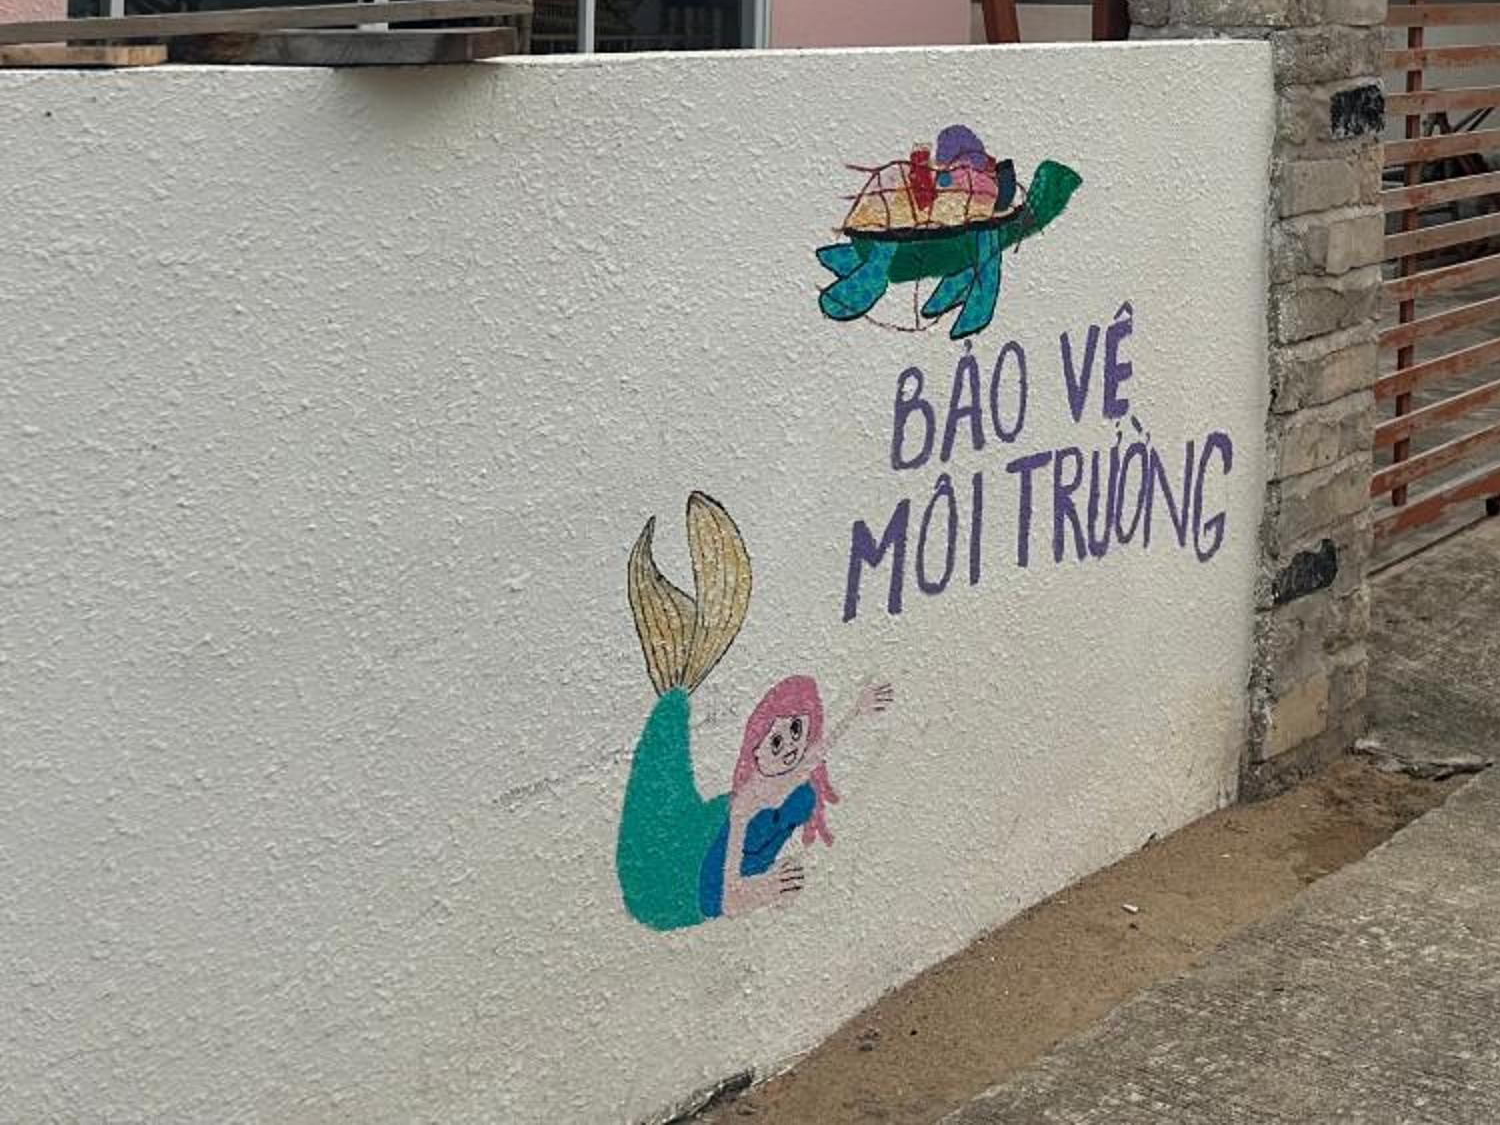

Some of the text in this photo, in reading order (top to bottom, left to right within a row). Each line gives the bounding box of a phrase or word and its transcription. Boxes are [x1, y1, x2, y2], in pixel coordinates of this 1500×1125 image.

[891, 301, 1133, 471] BẢO VỆ
[842, 415, 1234, 623] MÔI TRƯỜNG
